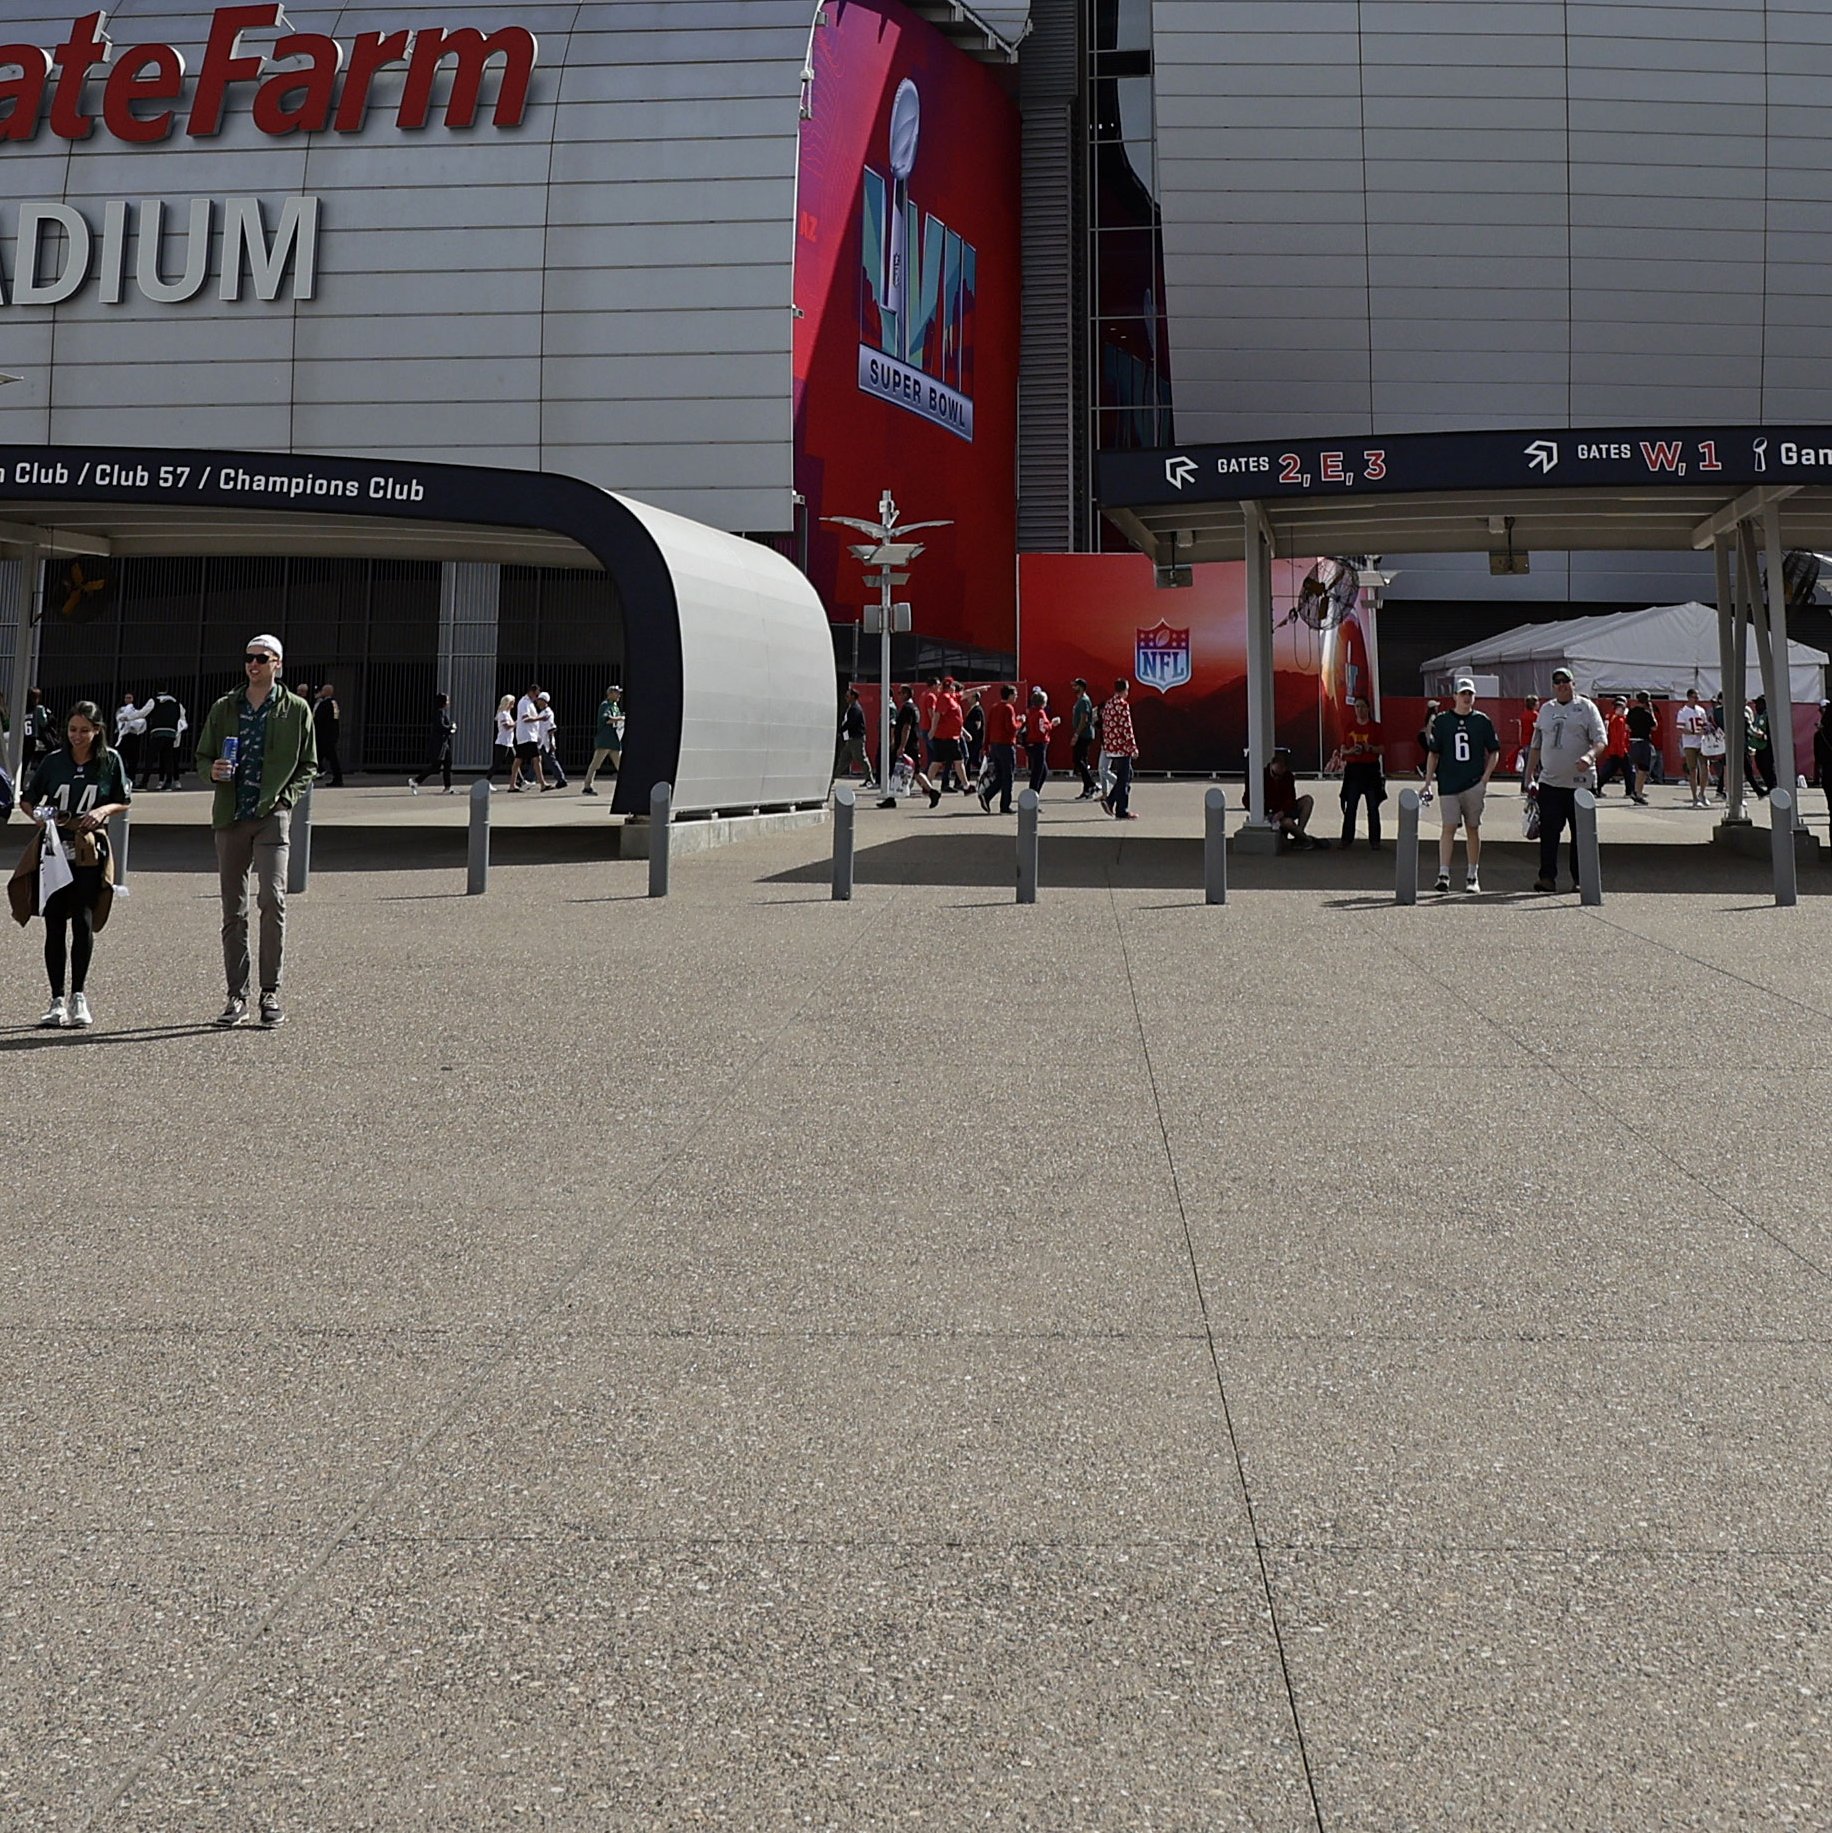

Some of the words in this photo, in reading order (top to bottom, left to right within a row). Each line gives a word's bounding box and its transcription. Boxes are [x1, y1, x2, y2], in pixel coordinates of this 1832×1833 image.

[870, 359, 922, 404] SUPER
[929, 387, 966, 428] BOWL
[1217, 456, 1269, 473] GATES
[1279, 453, 1311, 487] 2,
[1320, 451, 1354, 486] E,
[1364, 450, 1386, 480] 3
[1578, 444, 1631, 459] GATES
[1639, 441, 1686, 476] W,
[1698, 441, 1722, 470] 1
[15, 462, 69, 485] Club
[77, 462, 91, 485] /
[95, 464, 149, 487] Club
[159, 466, 191, 488] 57
[197, 466, 211, 490] /
[219, 468, 359, 498] Champions
[368, 477, 424, 502] Club
[1141, 651, 1185, 682] NFL
[1455, 732, 1471, 761] 6
[53, 783, 98, 815] 14
